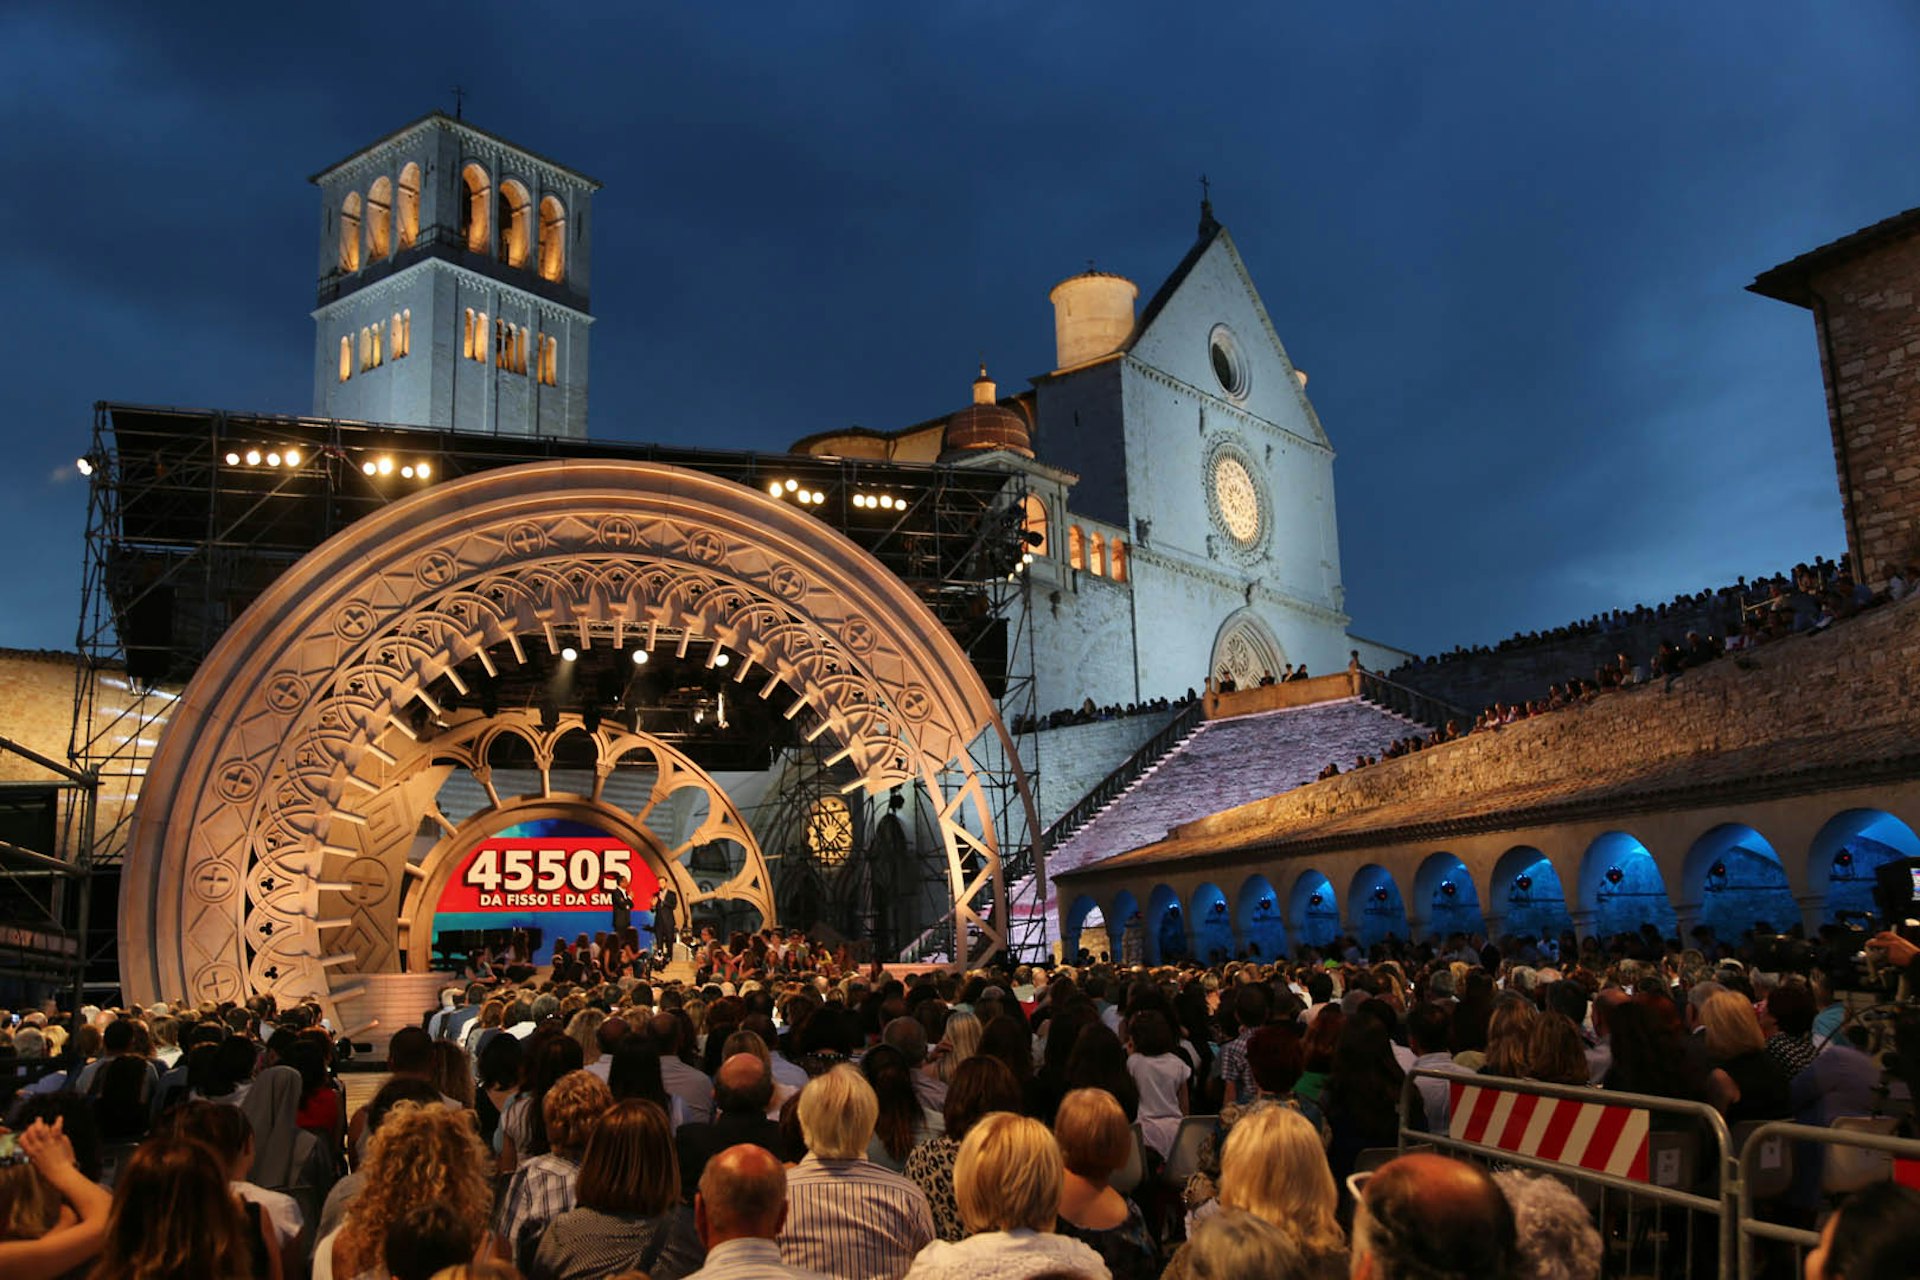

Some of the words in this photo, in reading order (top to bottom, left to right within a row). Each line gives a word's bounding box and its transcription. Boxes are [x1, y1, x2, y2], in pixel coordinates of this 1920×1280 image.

[467, 849, 632, 891] 45505
[480, 894, 502, 906] DA
[507, 894, 547, 906] FISSO
[552, 894, 561, 906] E
[565, 894, 587, 906] DA
[590, 893, 613, 905] SM
